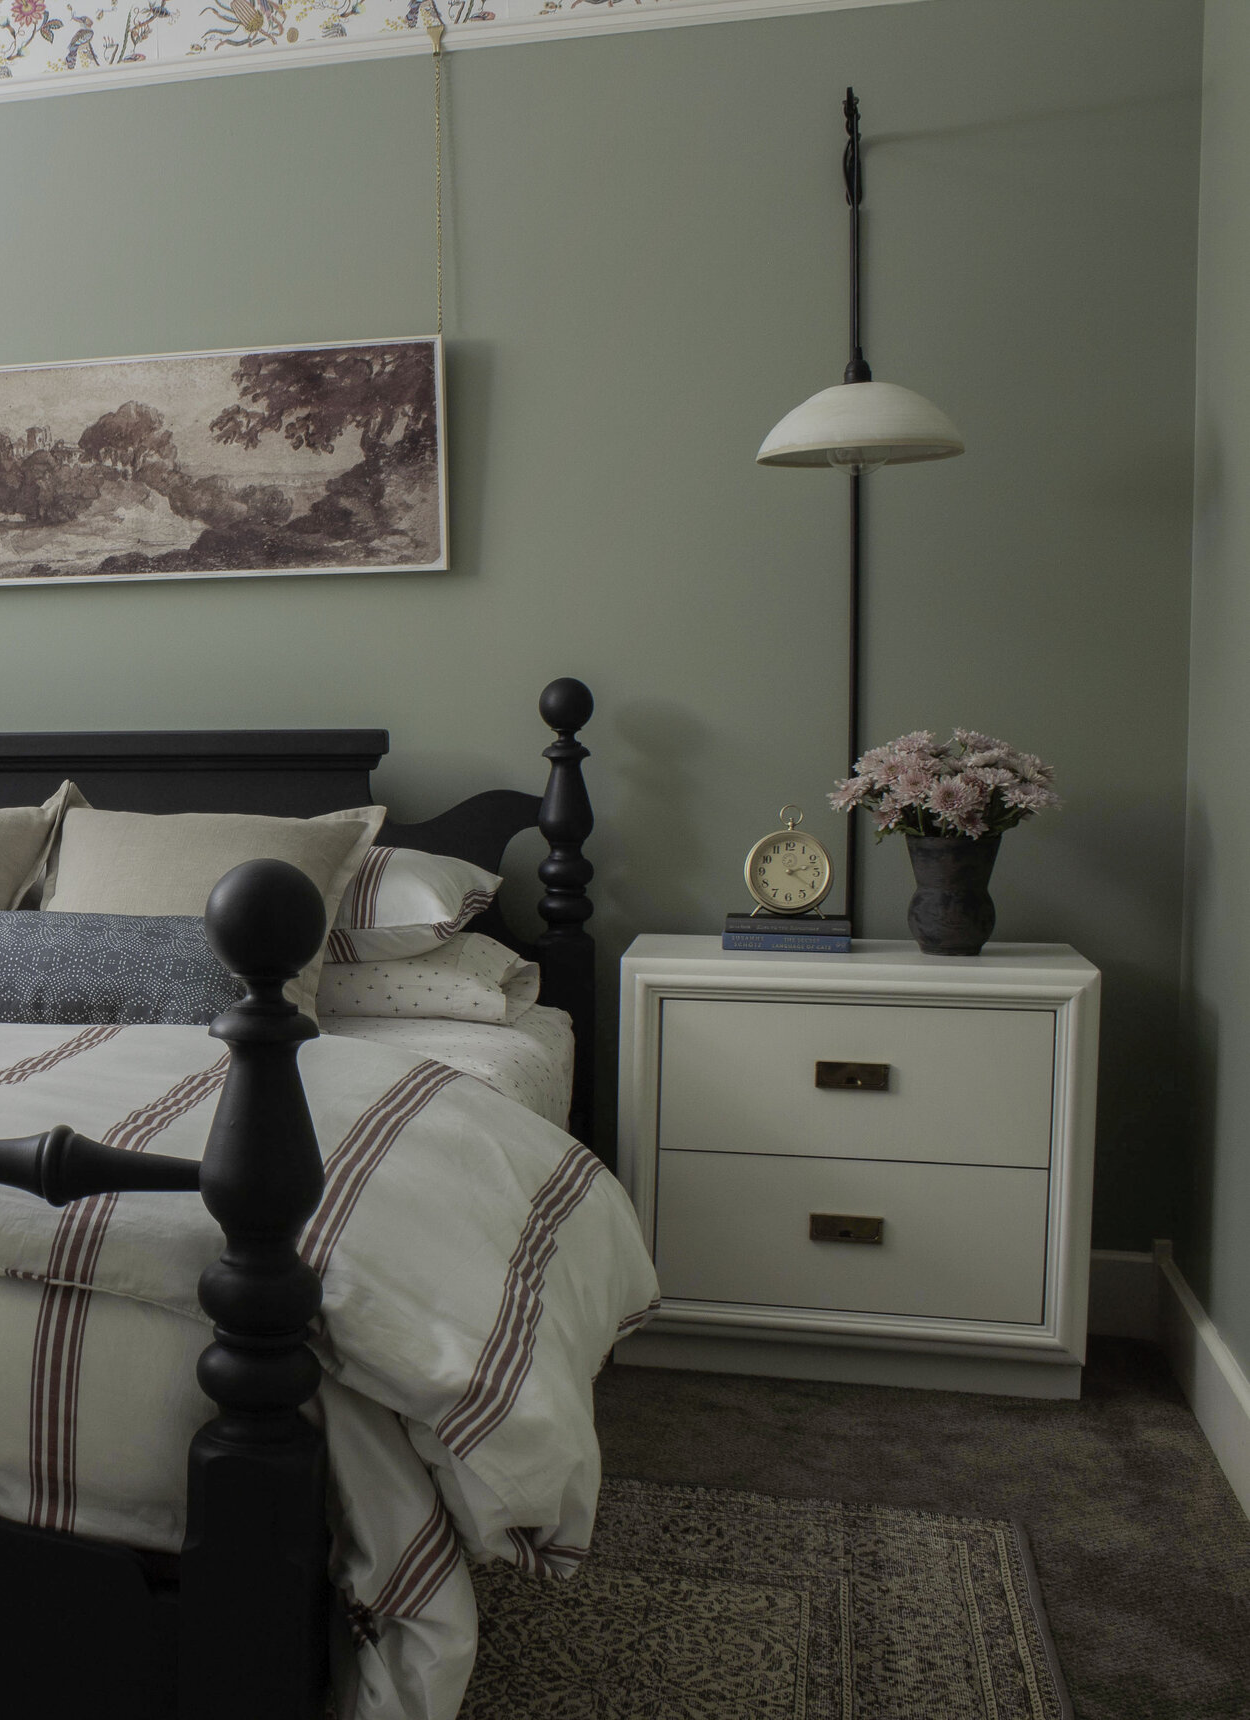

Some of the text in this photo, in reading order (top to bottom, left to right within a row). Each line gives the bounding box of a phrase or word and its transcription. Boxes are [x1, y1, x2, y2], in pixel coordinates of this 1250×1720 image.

[773, 845, 780, 854] 11
[785, 841, 796, 851] 12
[802, 845, 806, 854] 1
[762, 855, 772, 864] 10
[758, 867, 766, 876] 9
[762, 880, 769, 888] 8
[771, 888, 779, 898] 7
[785, 893, 792, 902] 6
[799, 890, 806, 898] 5
